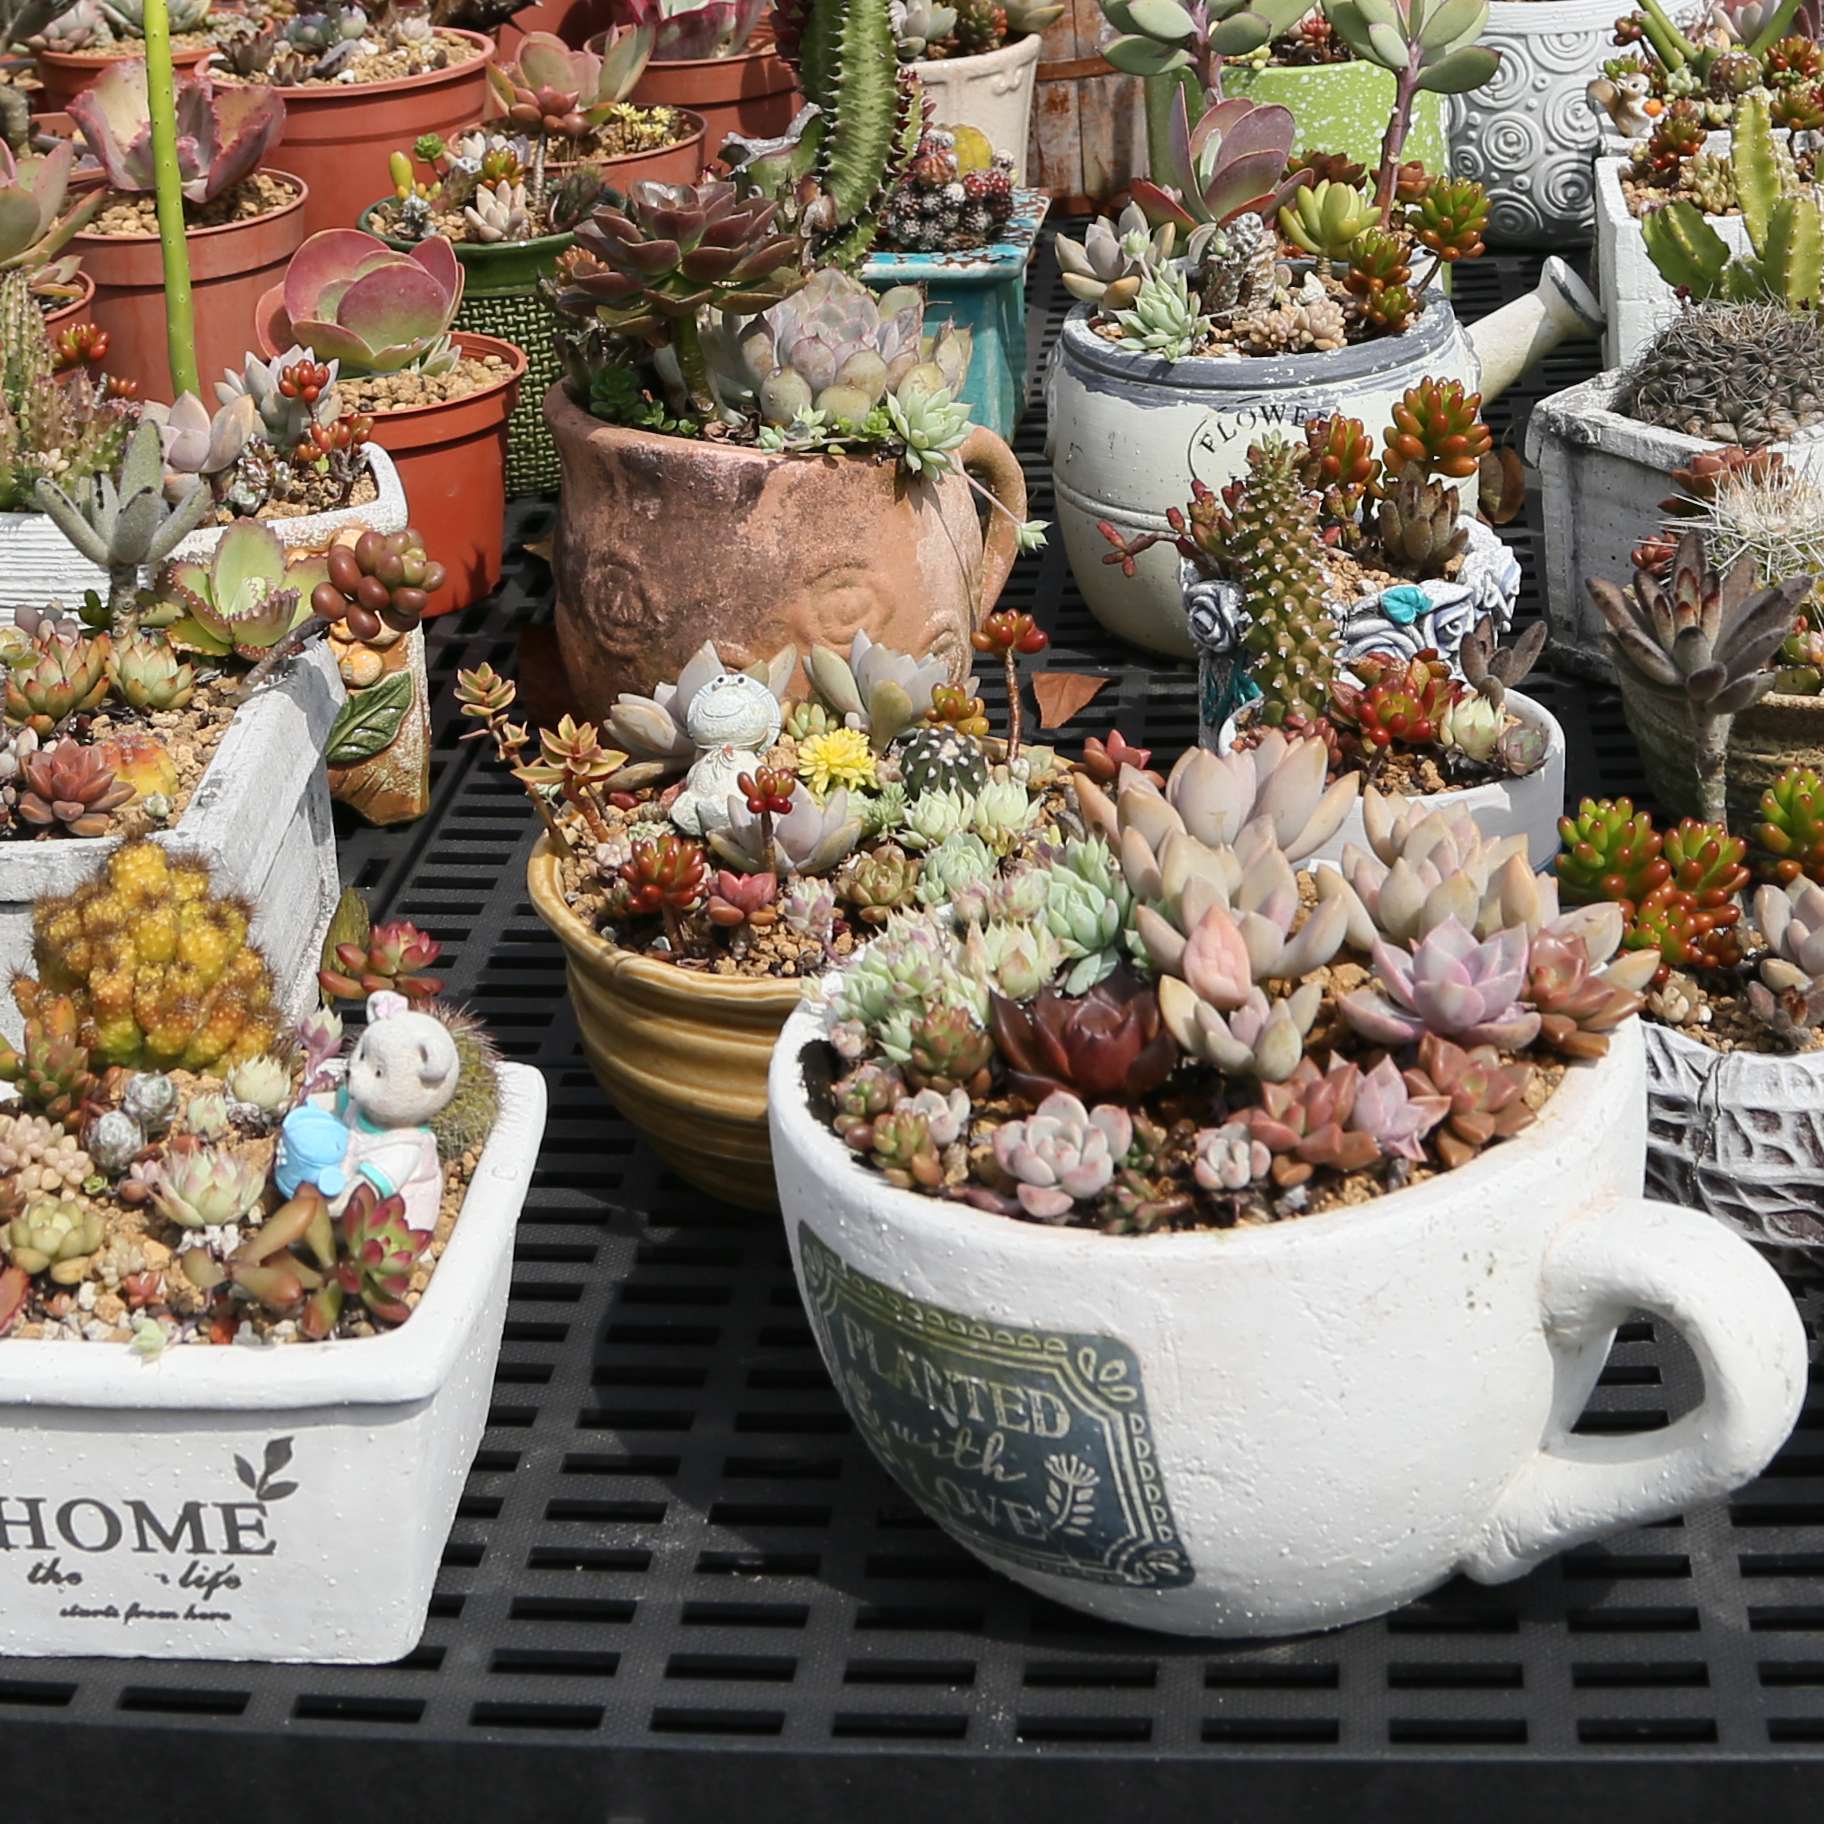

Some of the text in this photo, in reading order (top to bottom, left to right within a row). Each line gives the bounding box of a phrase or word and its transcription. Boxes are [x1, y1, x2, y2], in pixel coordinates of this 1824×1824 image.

[1198, 403, 1329, 454] FLOWE
[842, 1313, 1072, 1439] PLANTED
[889, 1421, 1027, 1482] with
[904, 1459, 1048, 1541] LOVE
[25, 1557, 83, 1586] the
[178, 1559, 243, 1601] life
